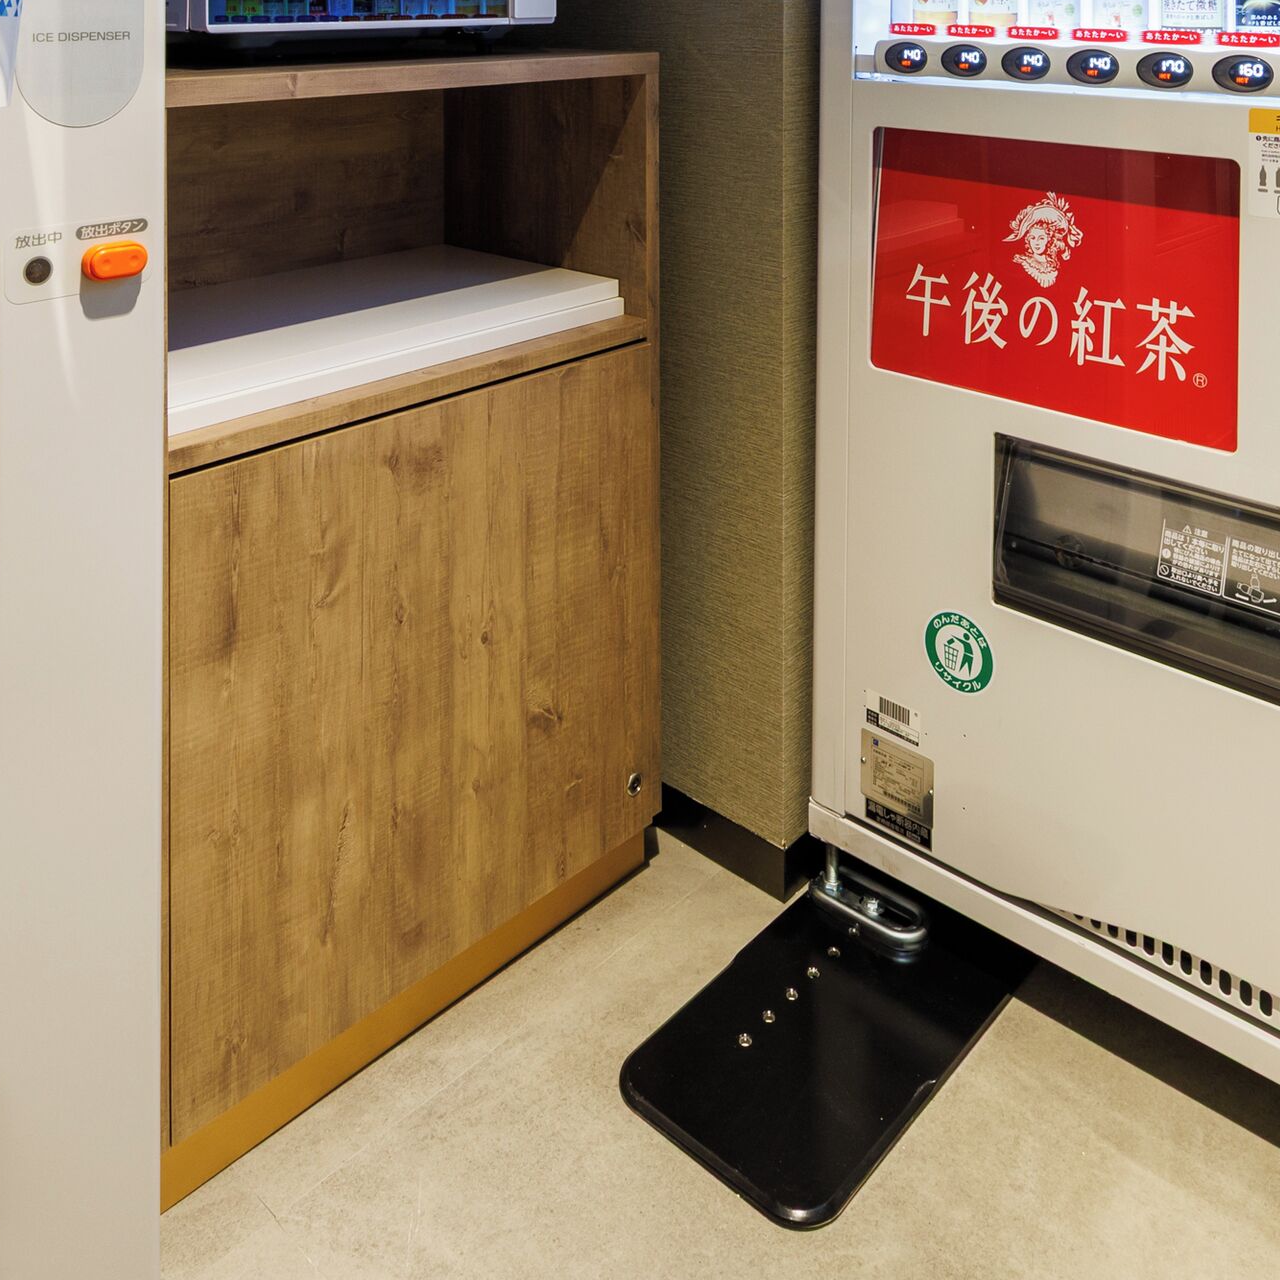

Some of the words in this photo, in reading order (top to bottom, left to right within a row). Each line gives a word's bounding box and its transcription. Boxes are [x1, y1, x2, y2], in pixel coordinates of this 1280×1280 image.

[32, 33, 54, 42] ICE
[58, 31, 130, 42] DISPENSER
[904, 49, 921, 60] 140
[1023, 55, 1042, 66] 140
[1090, 58, 1110, 69] 140
[1239, 64, 1263, 77] 160
[80, 220, 145, 239] 放出ボタン
[15, 232, 62, 249] 放出中
[906, 263, 1195, 382] 午後の紅茶
[933, 615, 987, 650] のんだあとは
[935, 661, 981, 692] リサイクル
